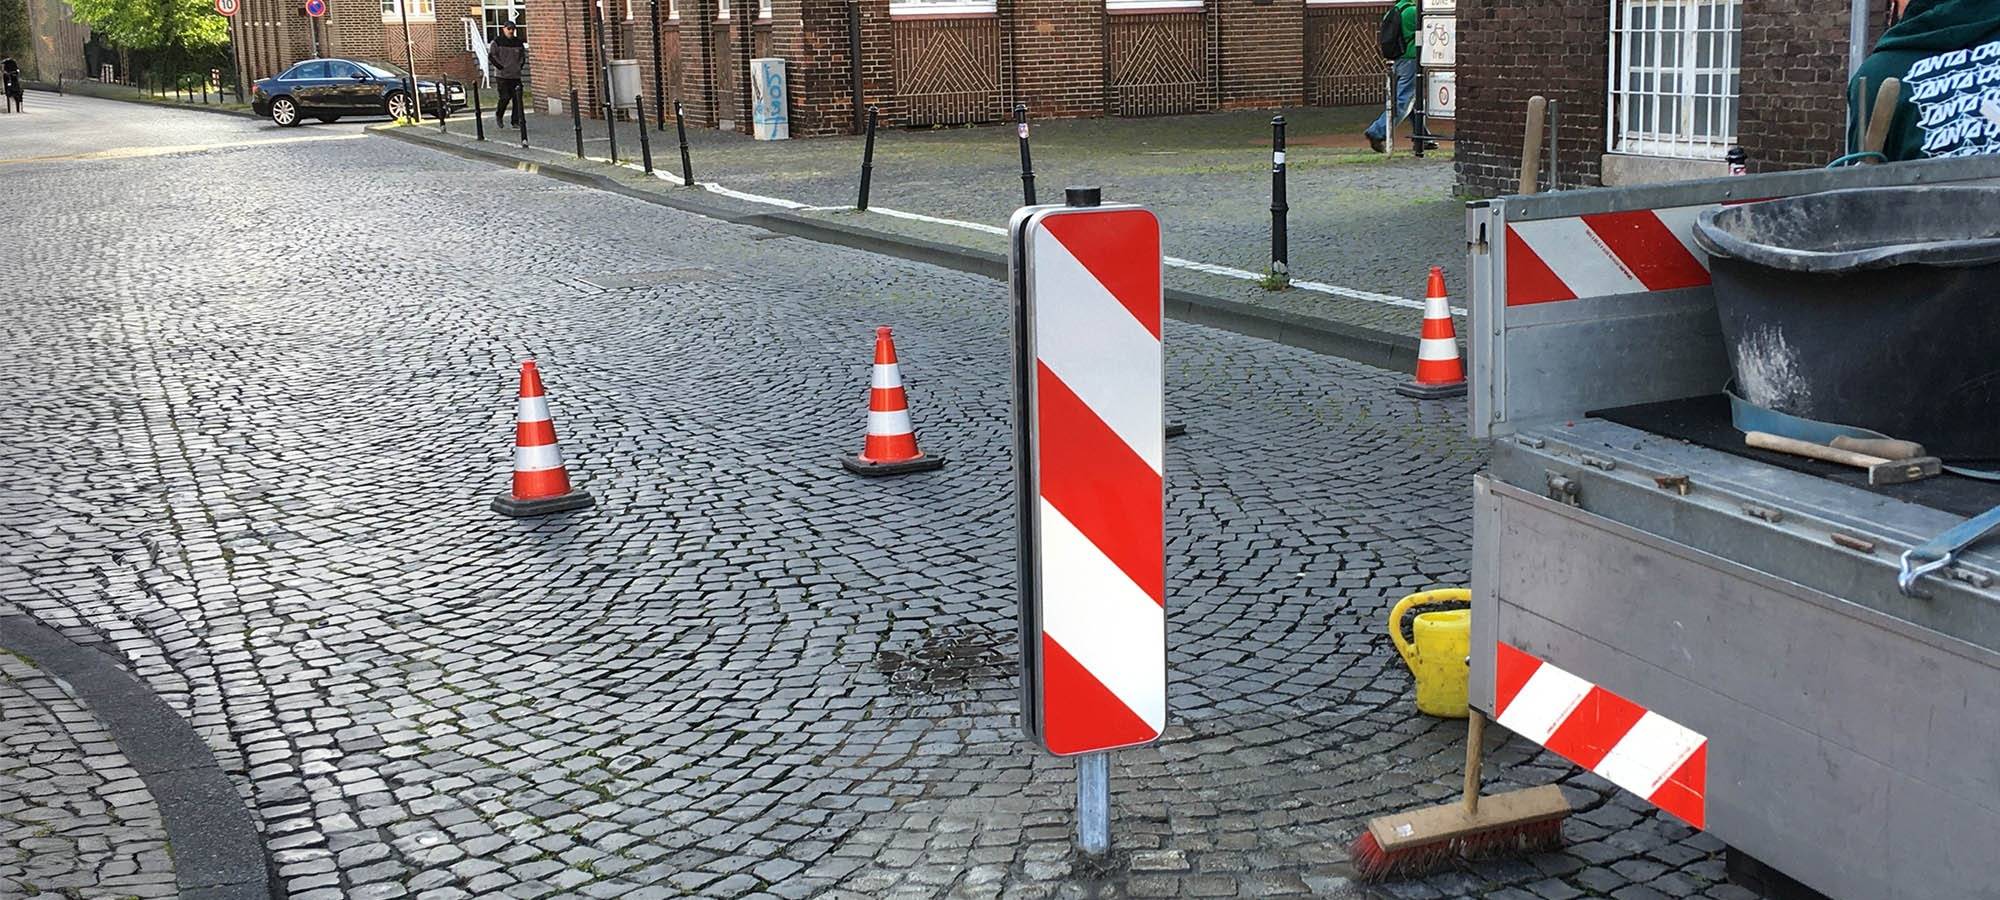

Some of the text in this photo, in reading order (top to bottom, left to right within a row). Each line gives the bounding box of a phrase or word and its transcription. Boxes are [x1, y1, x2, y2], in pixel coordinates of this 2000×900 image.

[1903, 49, 1967, 82] SANTA
[1909, 72, 1974, 102] SANTA
[1916, 95, 1979, 127] SANTA
[1920, 119, 1981, 150] SANTA
